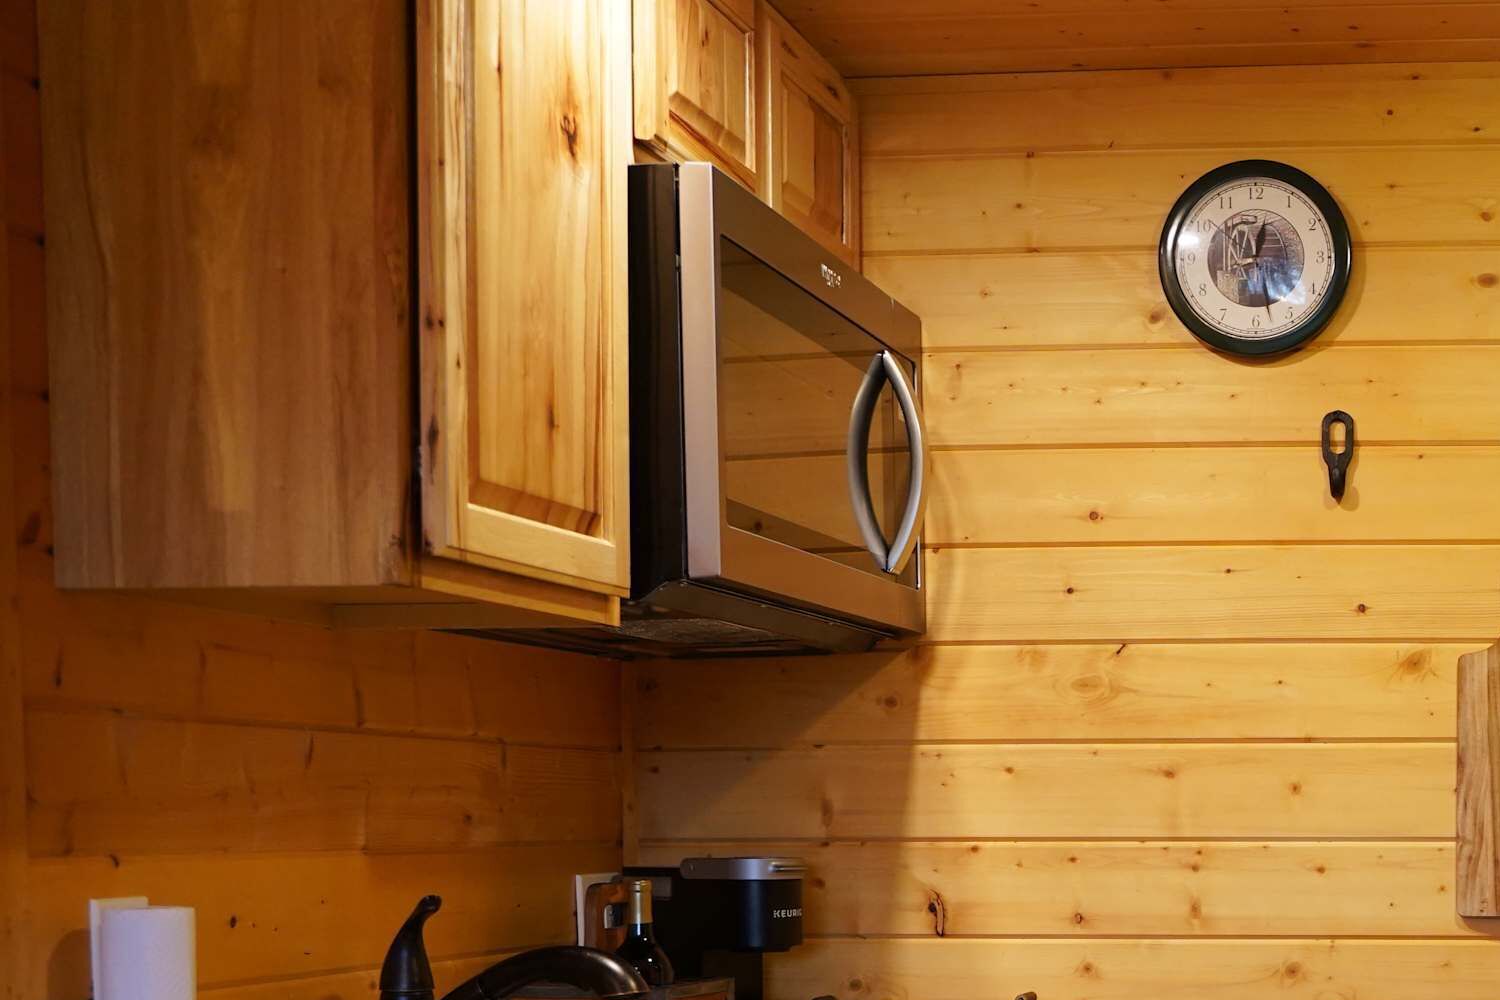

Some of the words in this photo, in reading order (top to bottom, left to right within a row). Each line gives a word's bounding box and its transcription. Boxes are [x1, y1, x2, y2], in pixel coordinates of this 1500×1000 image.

[1249, 187, 1264, 200] 12
[1219, 196, 1233, 209] 11
[1196, 220, 1212, 233] 10
[1308, 218, 1317, 231] 2
[1187, 253, 1196, 265] 9
[1316, 250, 1325, 264] 3
[1199, 283, 1207, 297] 8
[1219, 308, 1227, 321] 7
[1285, 306, 1293, 320] 5
[1252, 314, 1260, 328] 6
